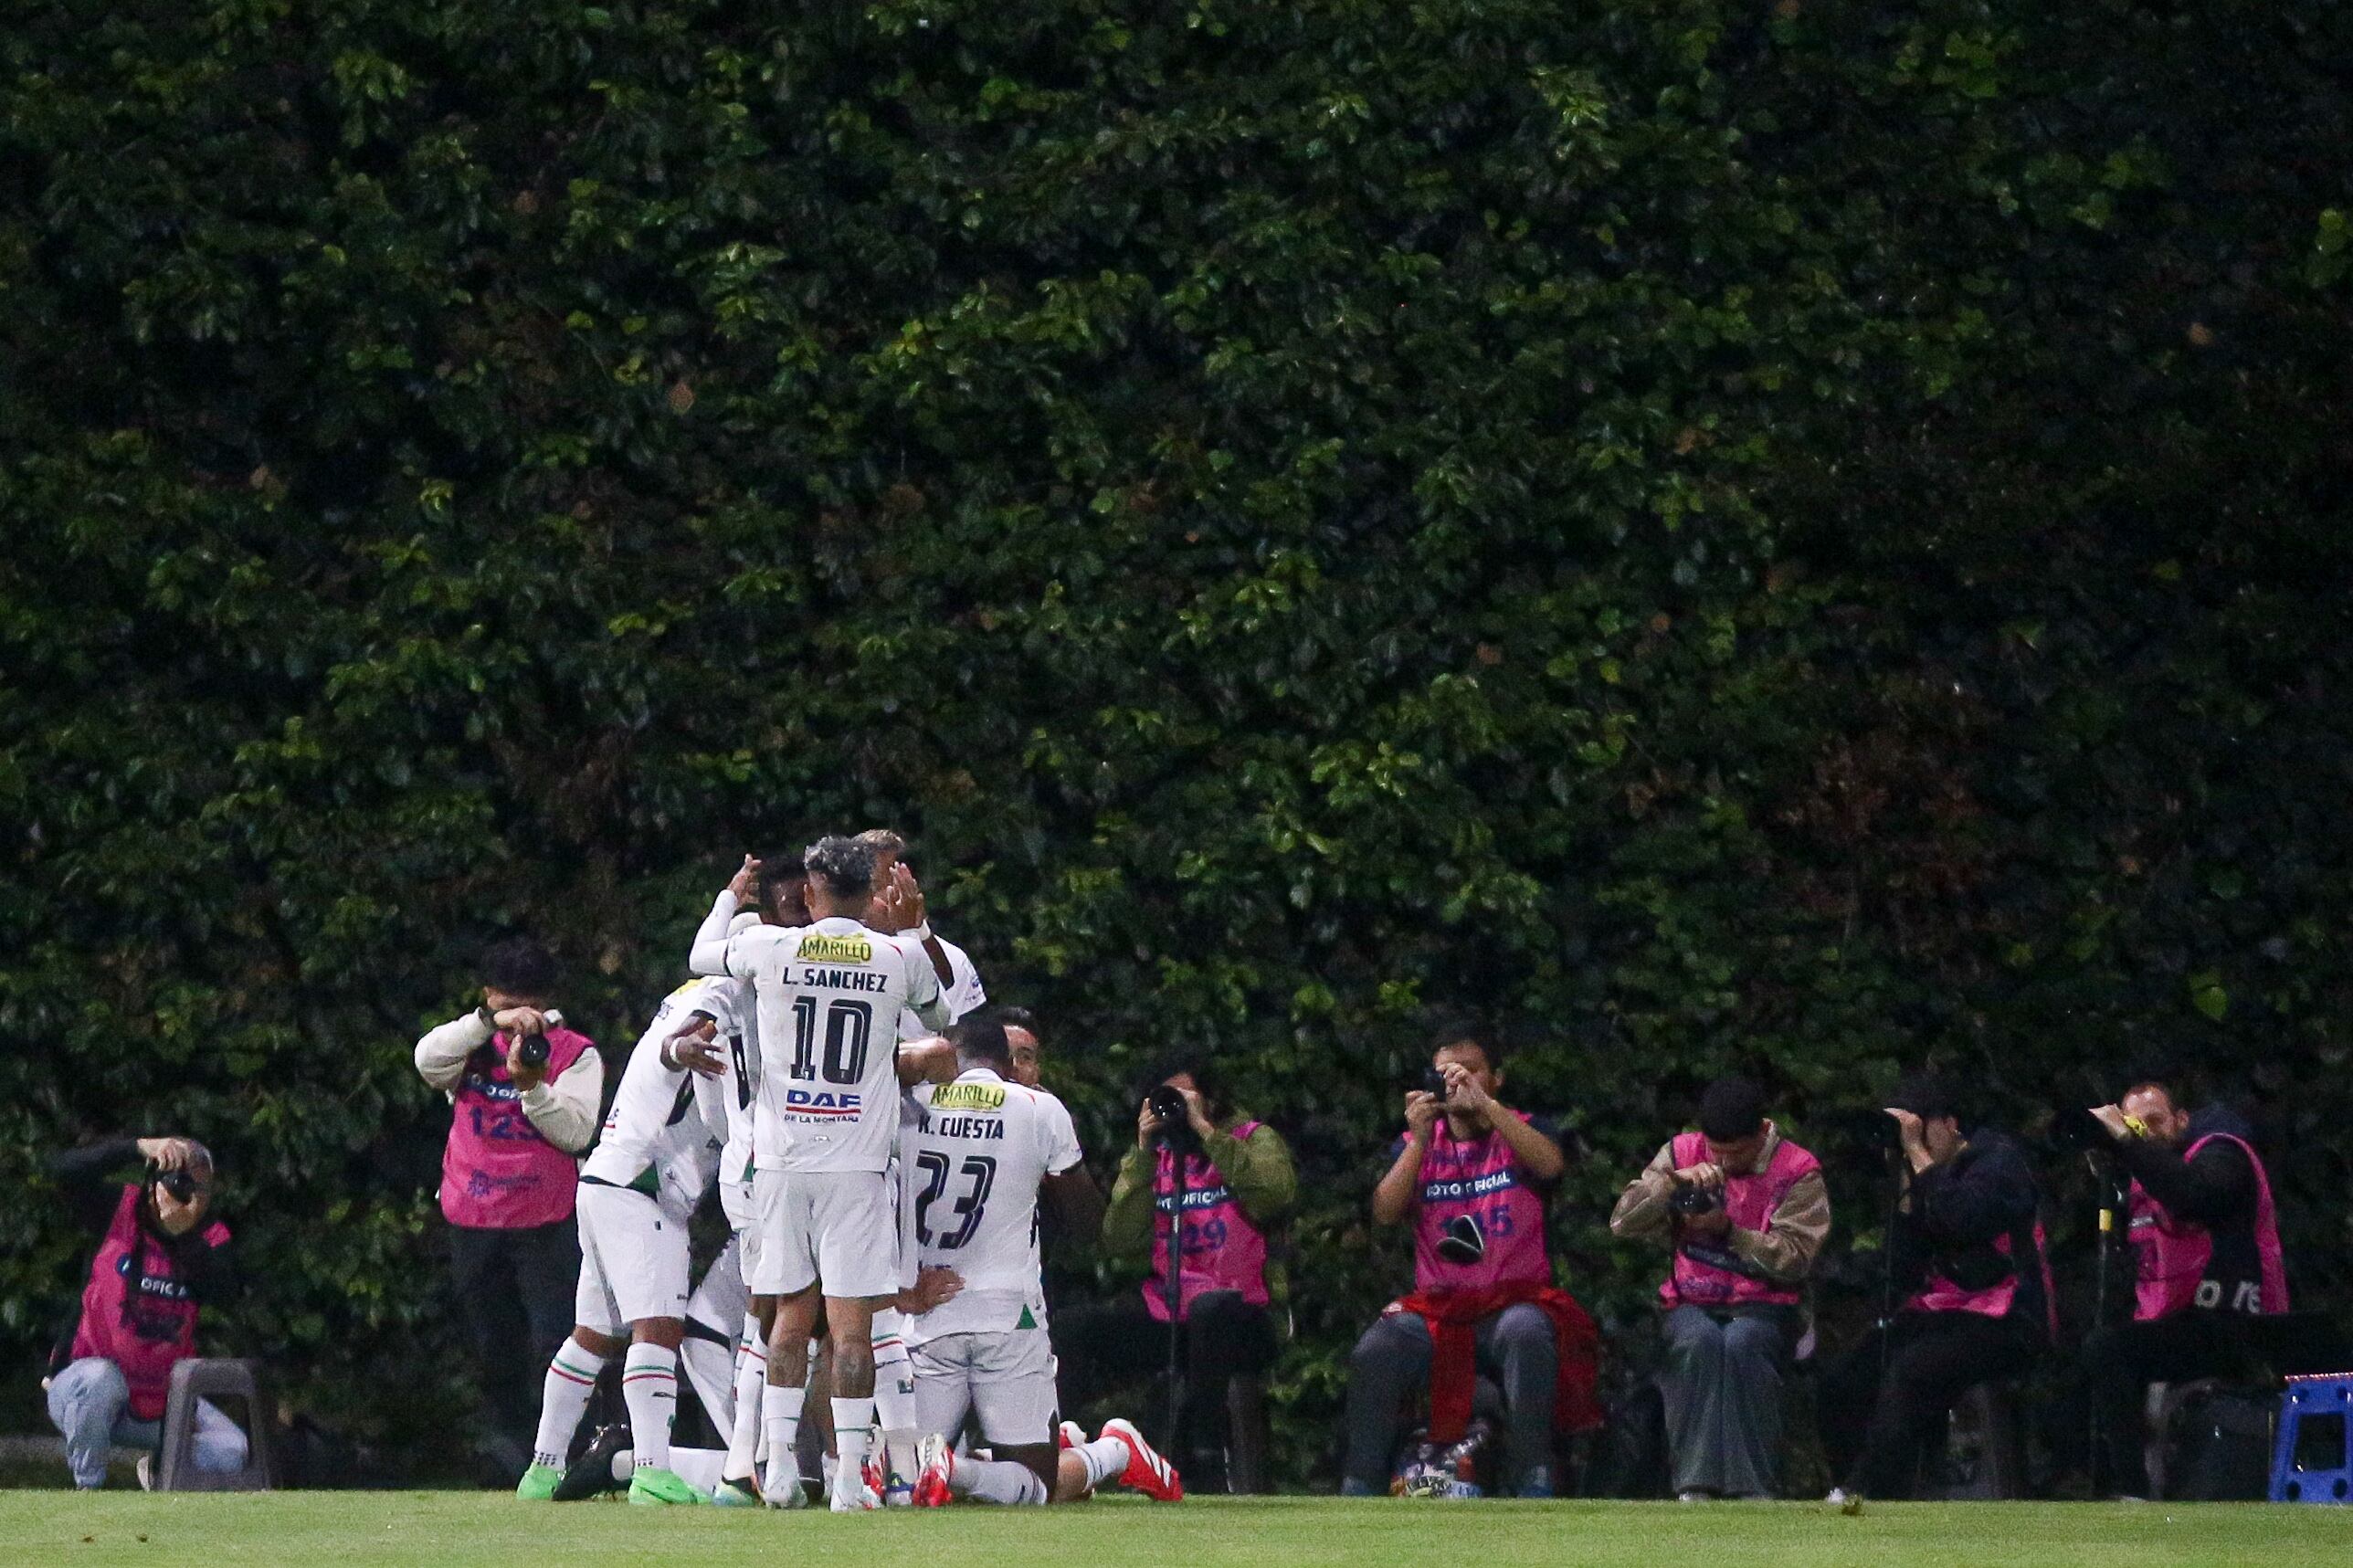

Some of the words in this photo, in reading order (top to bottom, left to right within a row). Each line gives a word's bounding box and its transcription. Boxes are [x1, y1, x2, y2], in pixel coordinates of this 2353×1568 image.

[797, 937, 871, 962] AMARILLO
[783, 966, 798, 985] L.
[804, 968, 888, 993] SANCHEZ
[790, 994, 872, 1085] 10
[786, 1089, 861, 1108] DAF
[930, 1085, 1005, 1108] AMARILLO
[940, 1117, 1004, 1140] CUESTA
[916, 1149, 997, 1250] 23
